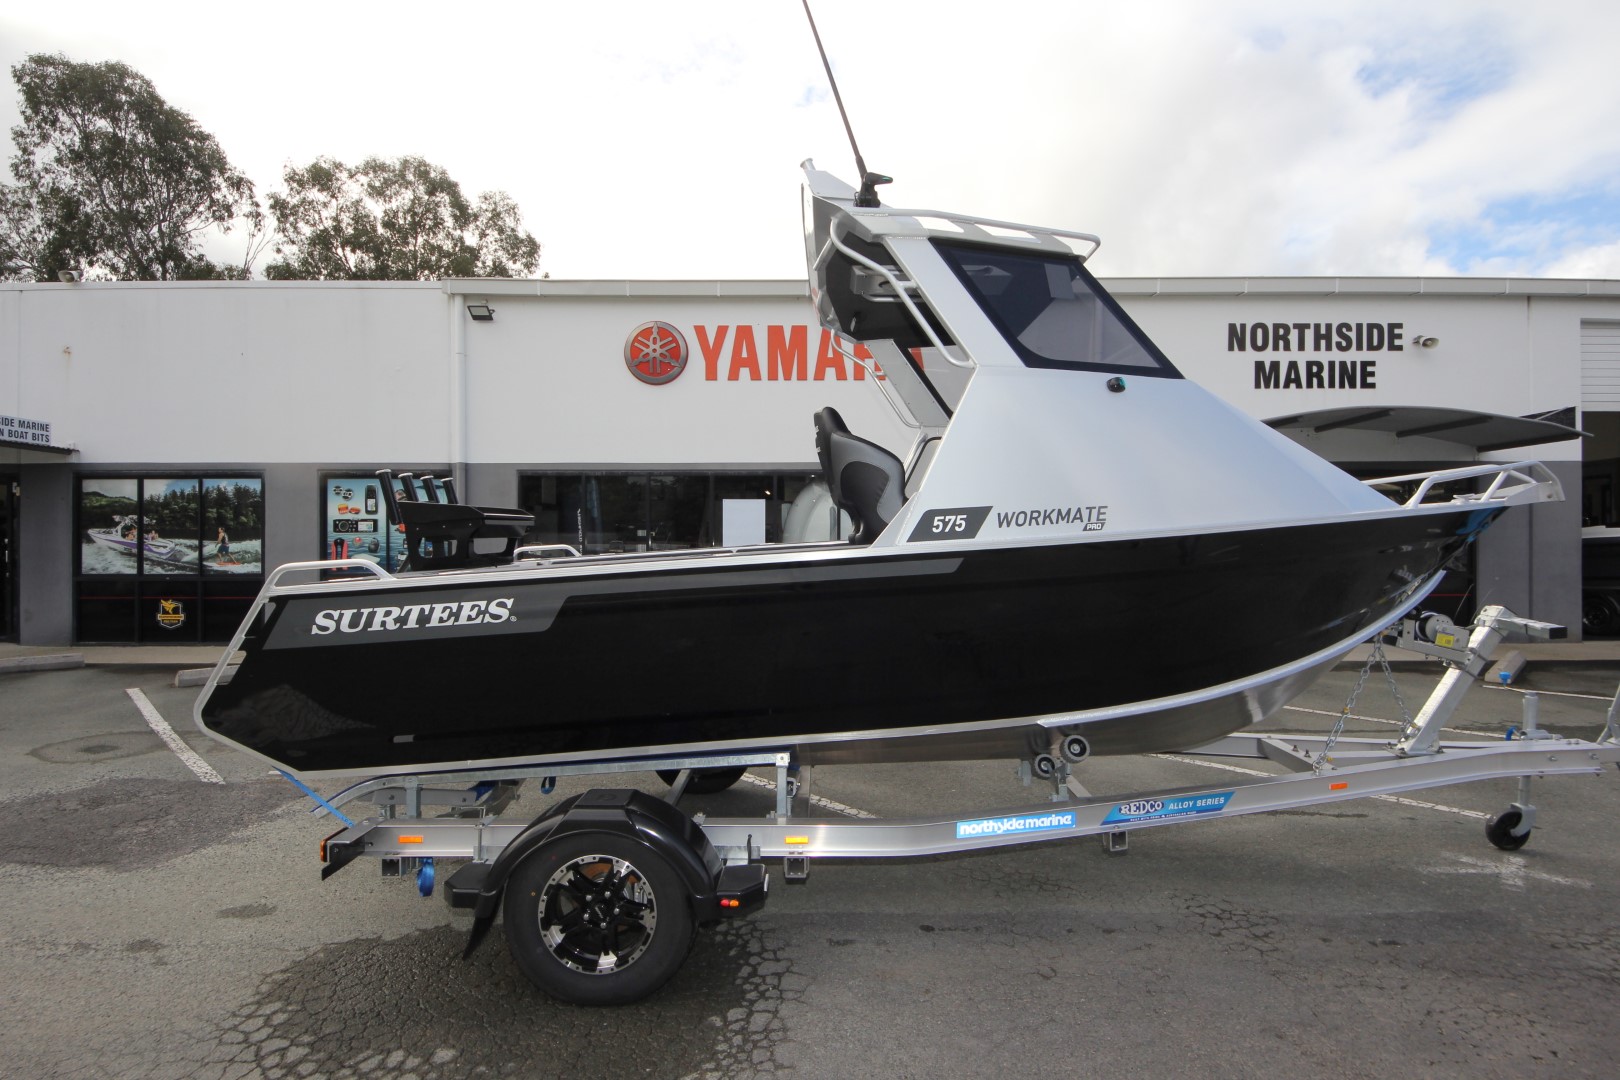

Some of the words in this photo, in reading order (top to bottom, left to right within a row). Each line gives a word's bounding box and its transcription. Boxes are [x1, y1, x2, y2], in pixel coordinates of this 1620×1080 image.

[1228, 322, 1403, 352] NORTHSIDE
[1254, 360, 1376, 389] MARINE
[0, 416, 15, 427] IDE
[18, 419, 50, 433] MARINE
[8, 428, 29, 440] BOAT
[31, 432, 50, 443] BITS
[932, 514, 967, 533] 575
[997, 505, 1108, 529] WORKMATE
[1086, 523, 1102, 531] PRO
[311, 598, 514, 635] SURTEES
[1120, 800, 1163, 815] REDCO
[1168, 800, 1194, 810] ALLOY
[1196, 797, 1225, 807] SERIES
[960, 818, 1025, 834] northside
[1025, 814, 1072, 829] marine
